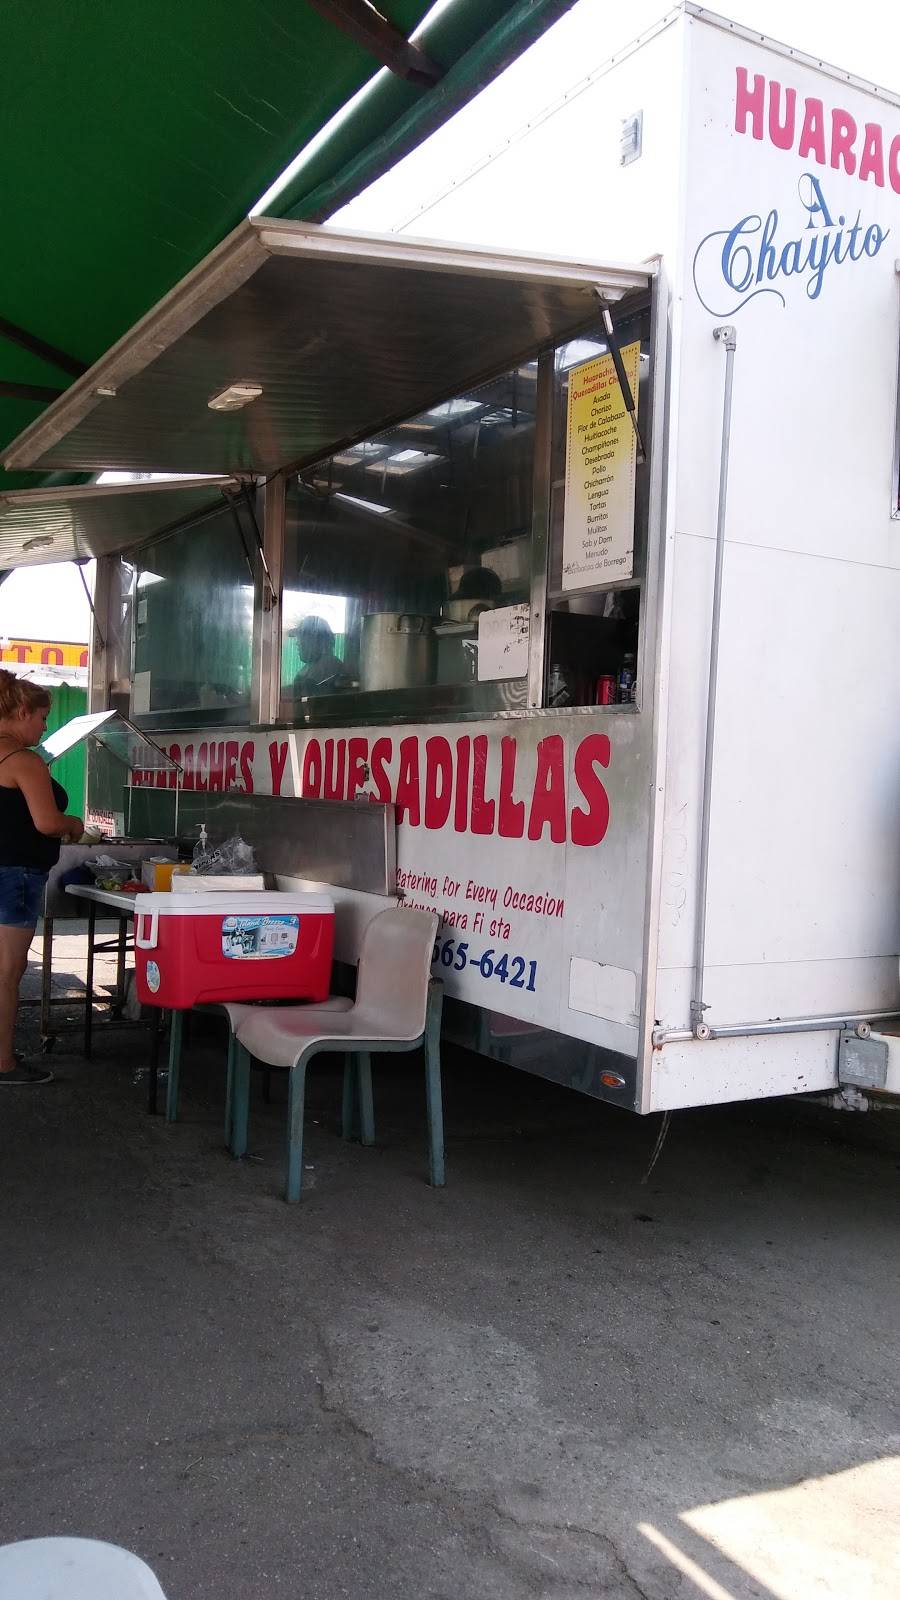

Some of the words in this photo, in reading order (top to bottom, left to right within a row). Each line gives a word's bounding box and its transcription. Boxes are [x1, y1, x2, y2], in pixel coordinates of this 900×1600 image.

[693, 209, 890, 317] Chayito
[572, 381, 607, 400] Quesadillas
[592, 391, 611, 404] Asada
[591, 404, 612, 417] Chorizo
[577, 424, 589, 435] Flor
[589, 421, 597, 430] de
[597, 411, 626, 426] Calabaza
[592, 465, 607, 475] Pollo
[587, 489, 609, 500] Lengua
[589, 502, 607, 511] Tortas
[586, 513, 609, 524] Burritos
[587, 525, 608, 535] Mulitas
[585, 548, 609, 560] Menudo
[603, 557, 627, 568] Borrego
[268, 741, 289, 797] Y
[301, 733, 611, 847] QUESADILLAS
[396, 867, 438, 898] Catering
[442, 875, 461, 898] for
[465, 879, 499, 912] Every
[503, 886, 565, 919] Occasion
[441, 908, 468, 931] para
